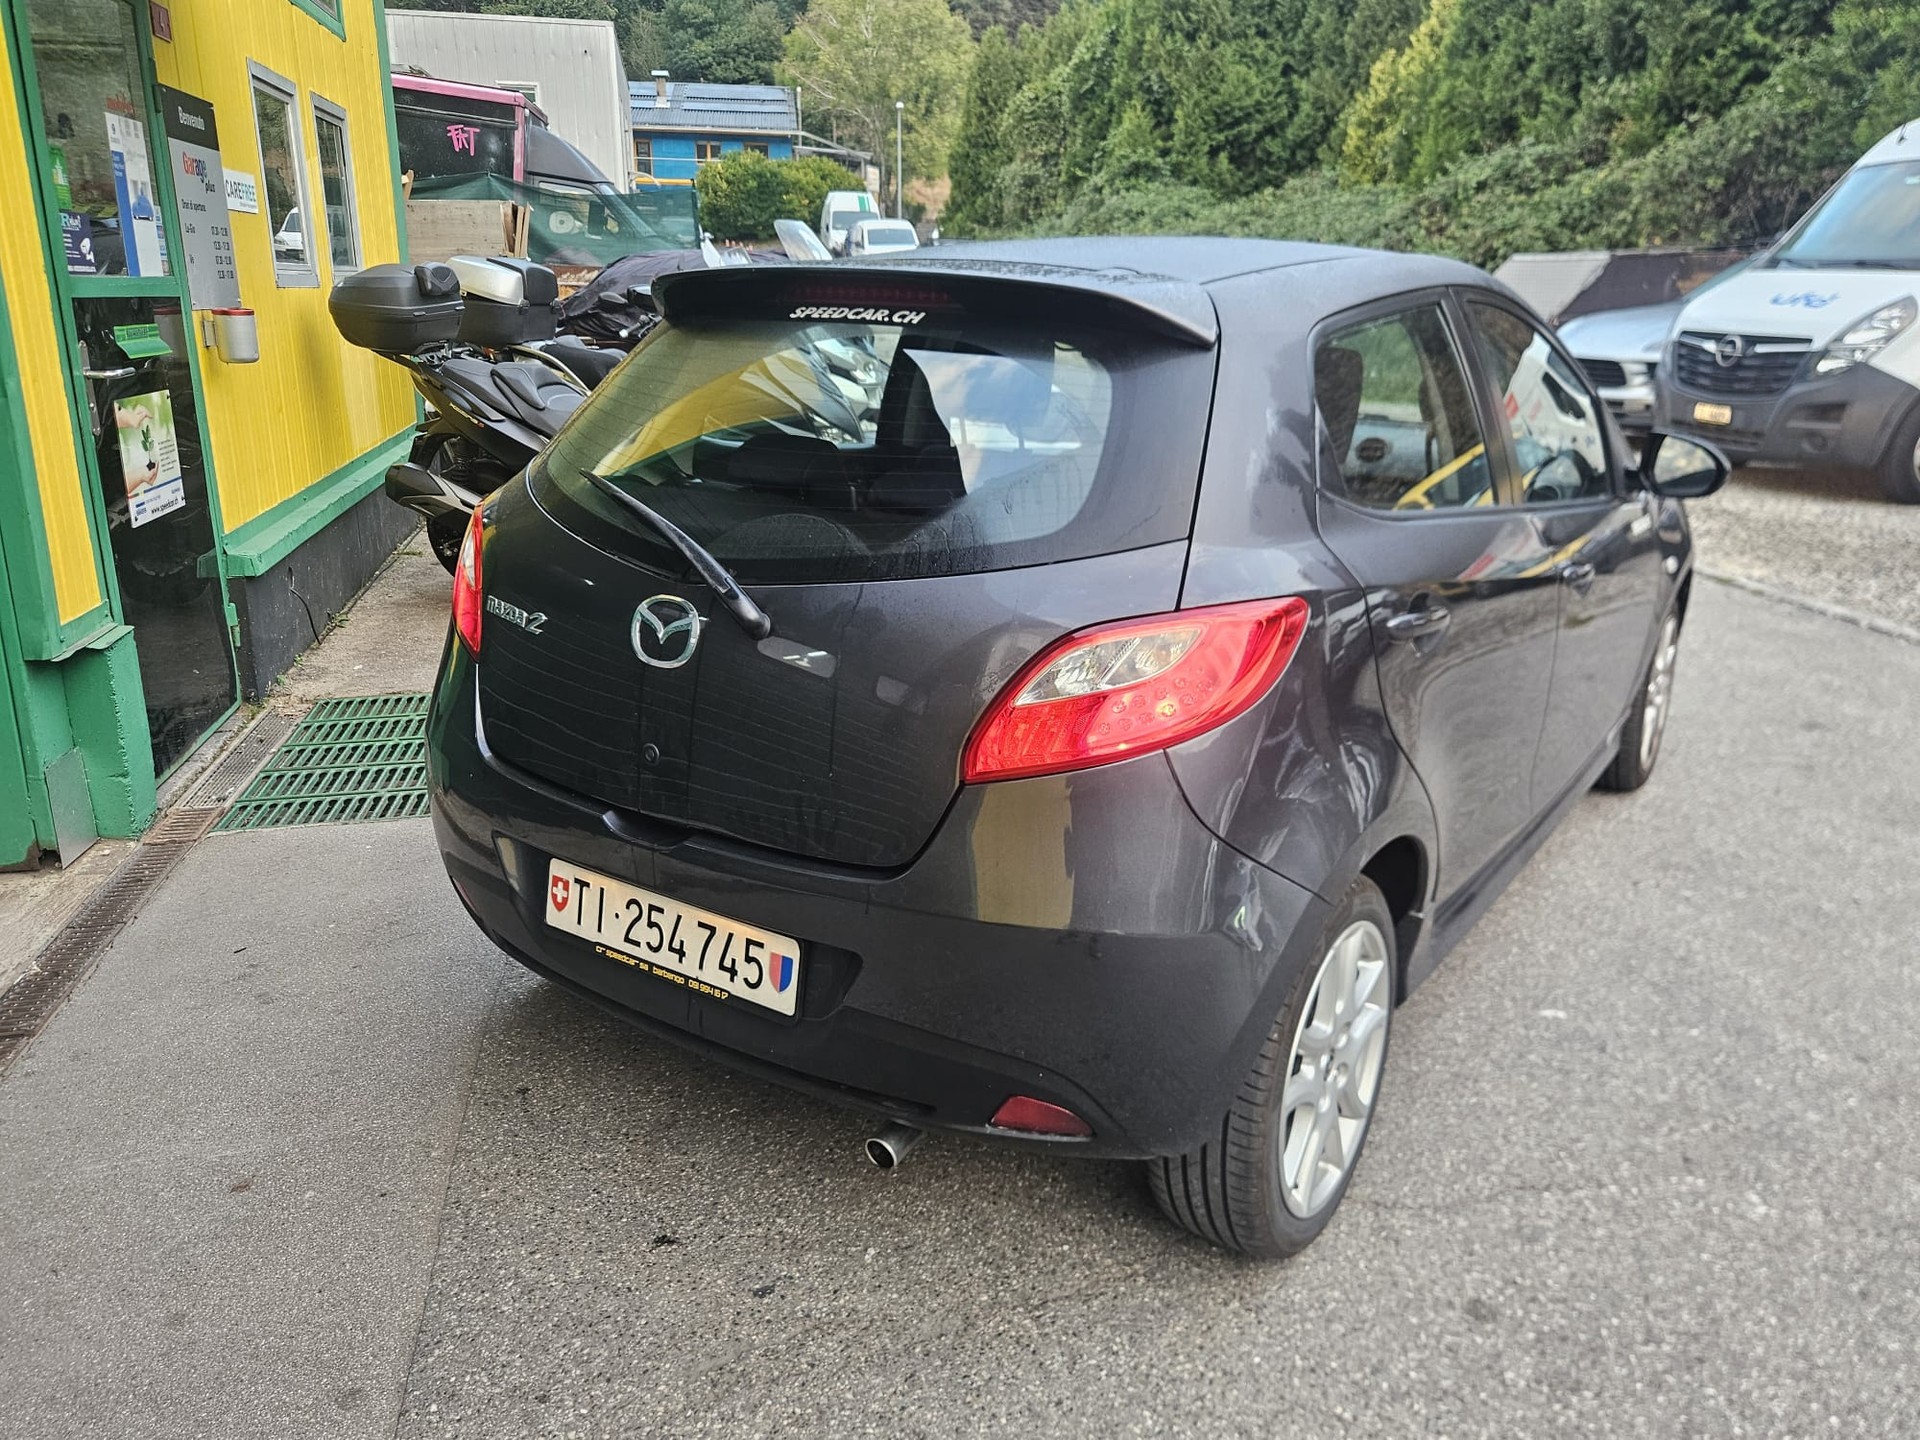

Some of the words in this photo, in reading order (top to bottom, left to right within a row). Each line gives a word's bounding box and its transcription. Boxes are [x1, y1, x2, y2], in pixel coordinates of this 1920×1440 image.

[178, 105, 205, 131] Benvenuto
[182, 151, 208, 183] Garage
[204, 179, 216, 194] plus
[224, 179, 256, 202] CAREFREE
[789, 306, 926, 325] SPEEDCAR.CH
[606, 949, 639, 966] speedcar
[652, 966, 685, 984] barbengo
